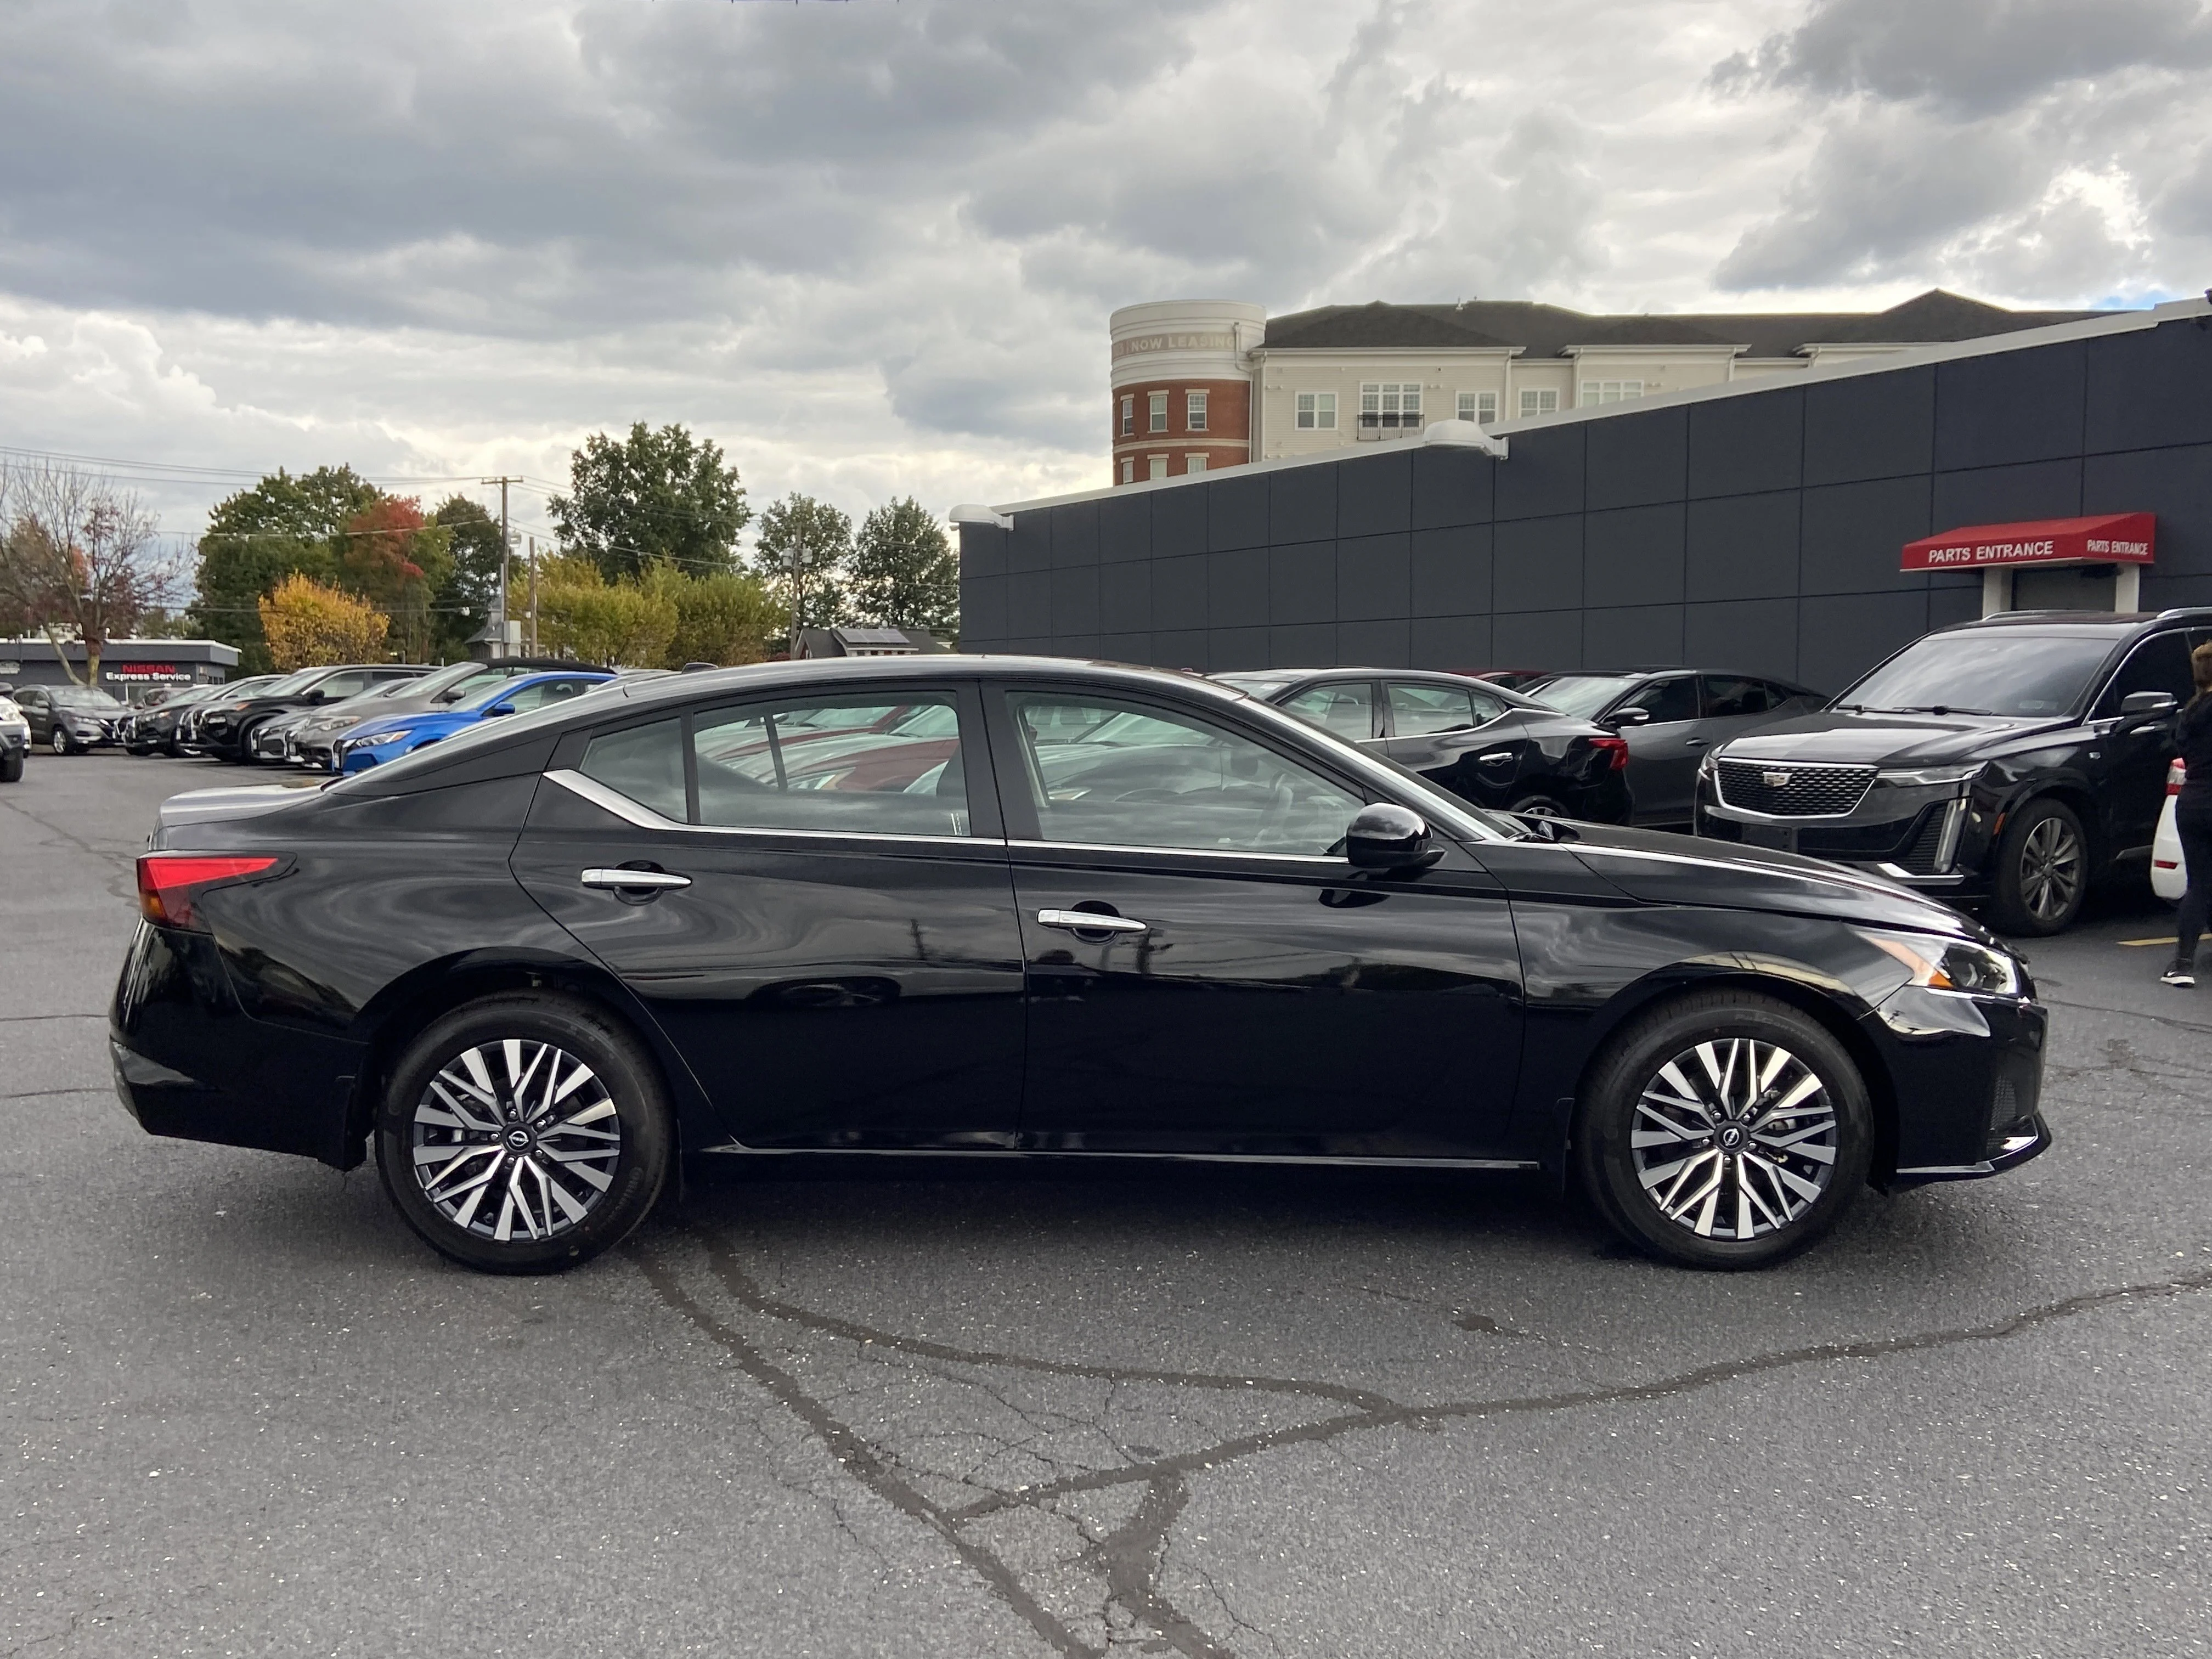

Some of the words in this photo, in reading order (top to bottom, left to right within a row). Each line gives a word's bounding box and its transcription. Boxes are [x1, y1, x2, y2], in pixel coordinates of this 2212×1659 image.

[1131, 337, 1163, 352] NOW
[1168, 335, 1234, 348] LEASING
[1928, 547, 1971, 563] PARTS
[1976, 540, 2054, 560] ENTRANCE
[2087, 539, 2110, 553] PARTS
[2111, 541, 2148, 555] ENTRANCE
[106, 672, 150, 681] Express
[153, 672, 191, 681] Service
[122, 664, 176, 674] NISSAN
